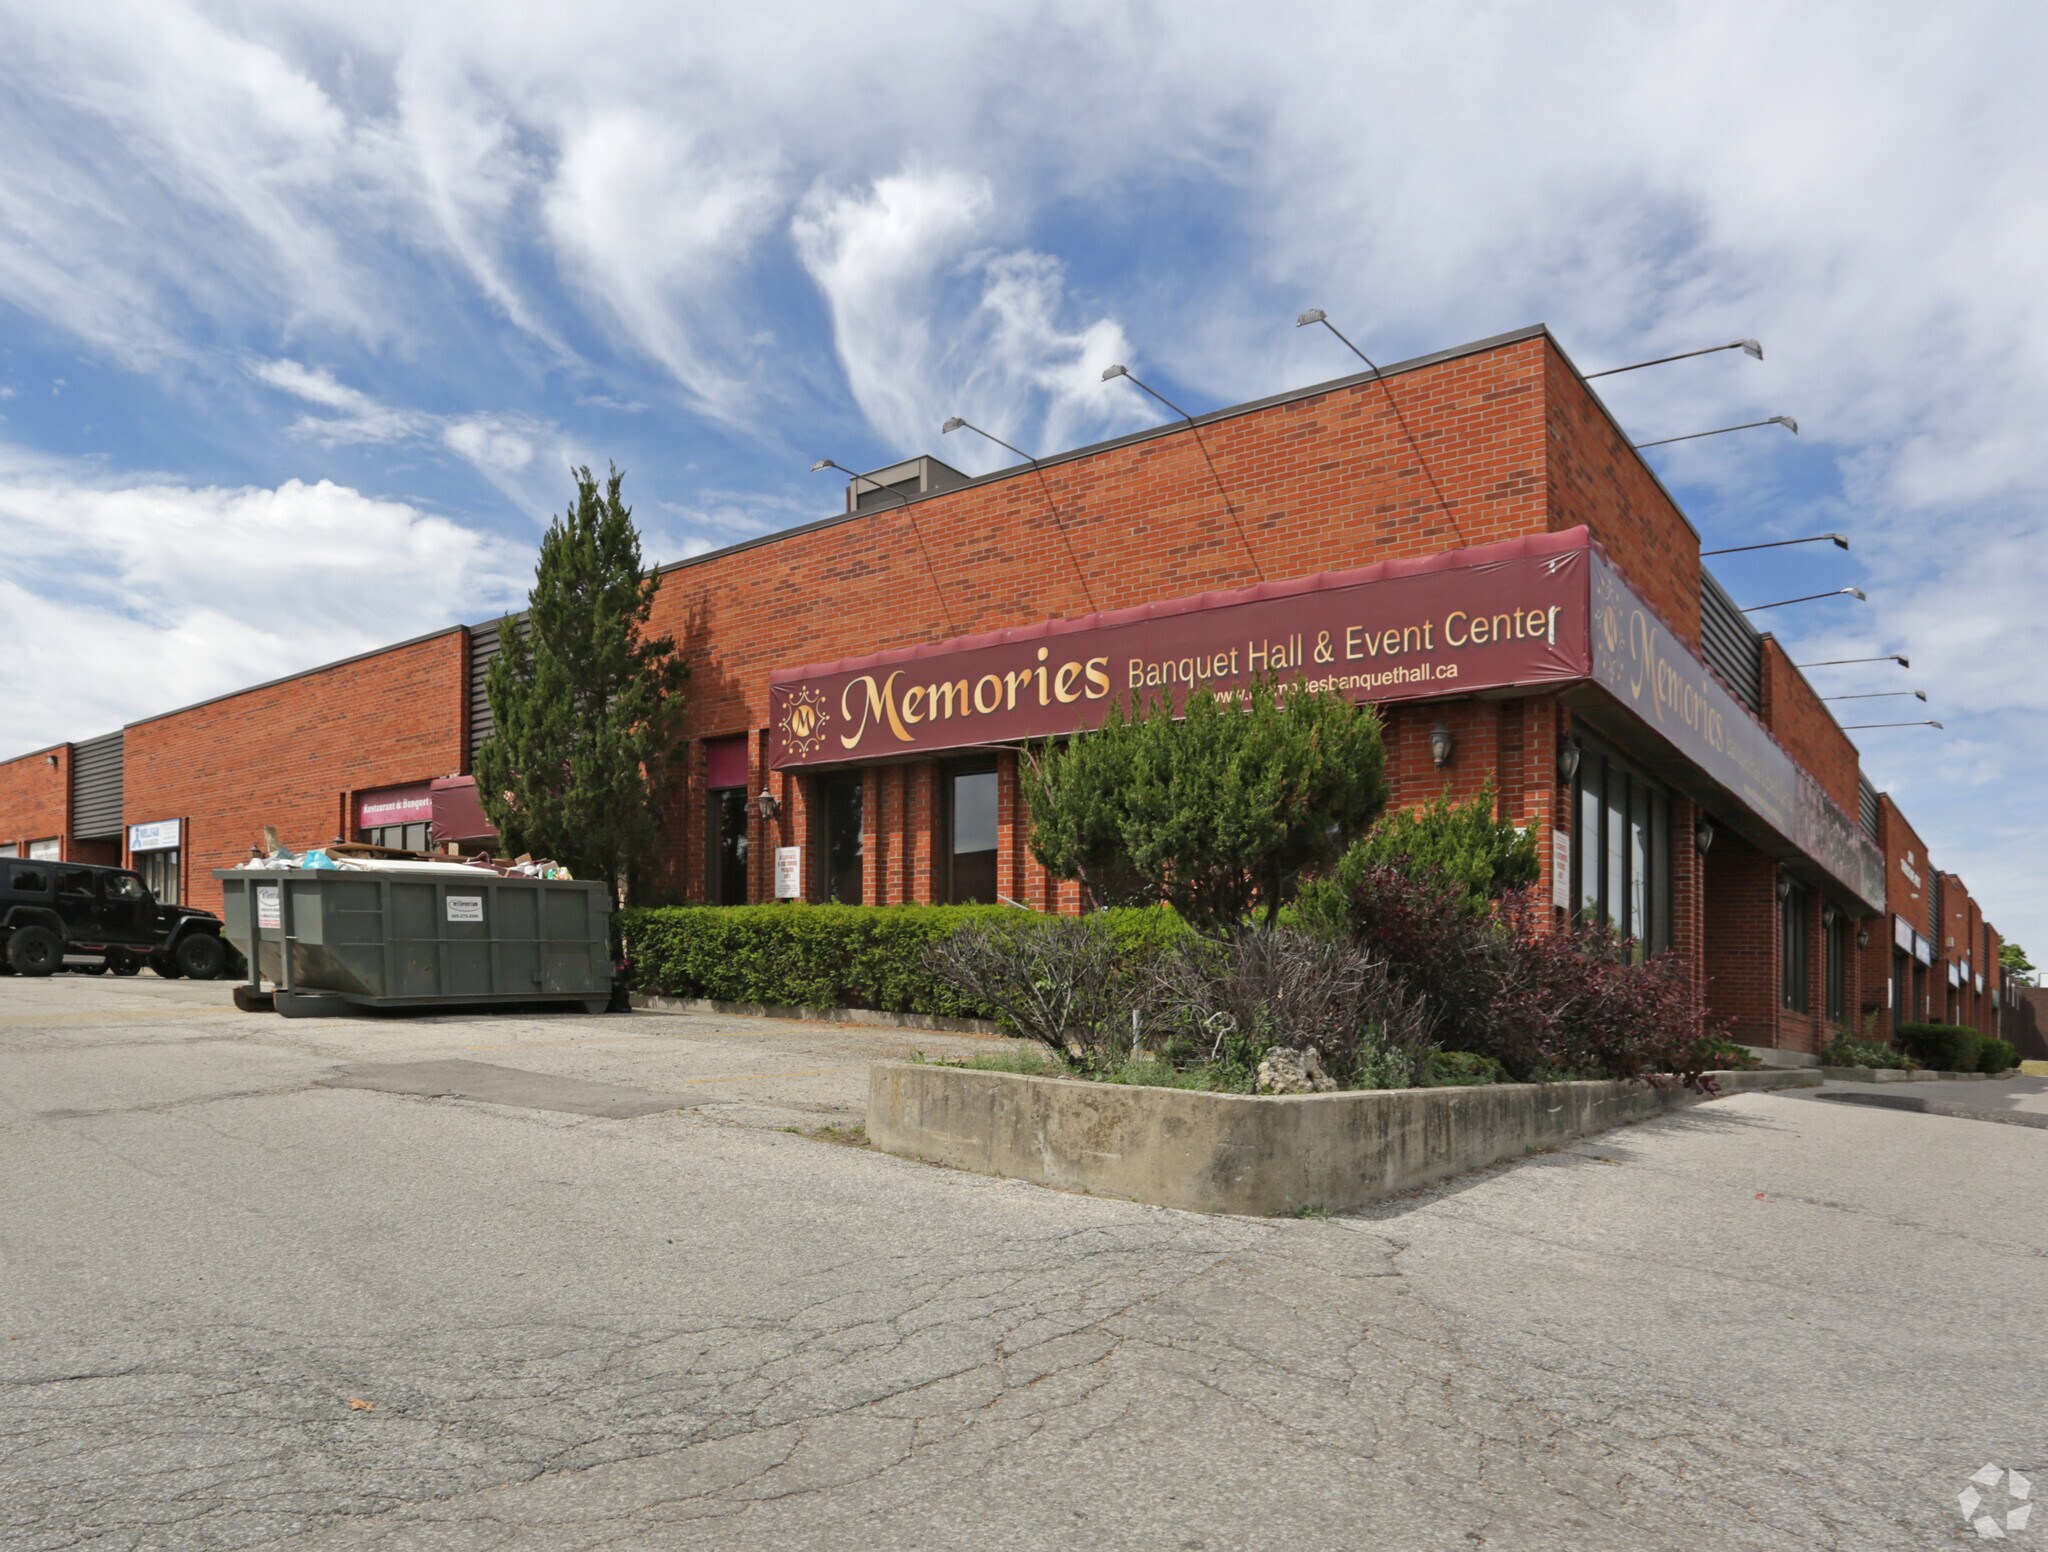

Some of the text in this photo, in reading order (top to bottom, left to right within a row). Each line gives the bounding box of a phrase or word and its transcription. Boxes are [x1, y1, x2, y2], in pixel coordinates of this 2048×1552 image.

[1129, 605, 1561, 689] Banquet Hall & Event Center
[1630, 610, 1723, 752] Memories
[840, 647, 1110, 749] Memories
[402, 797, 429, 810] Banquet
